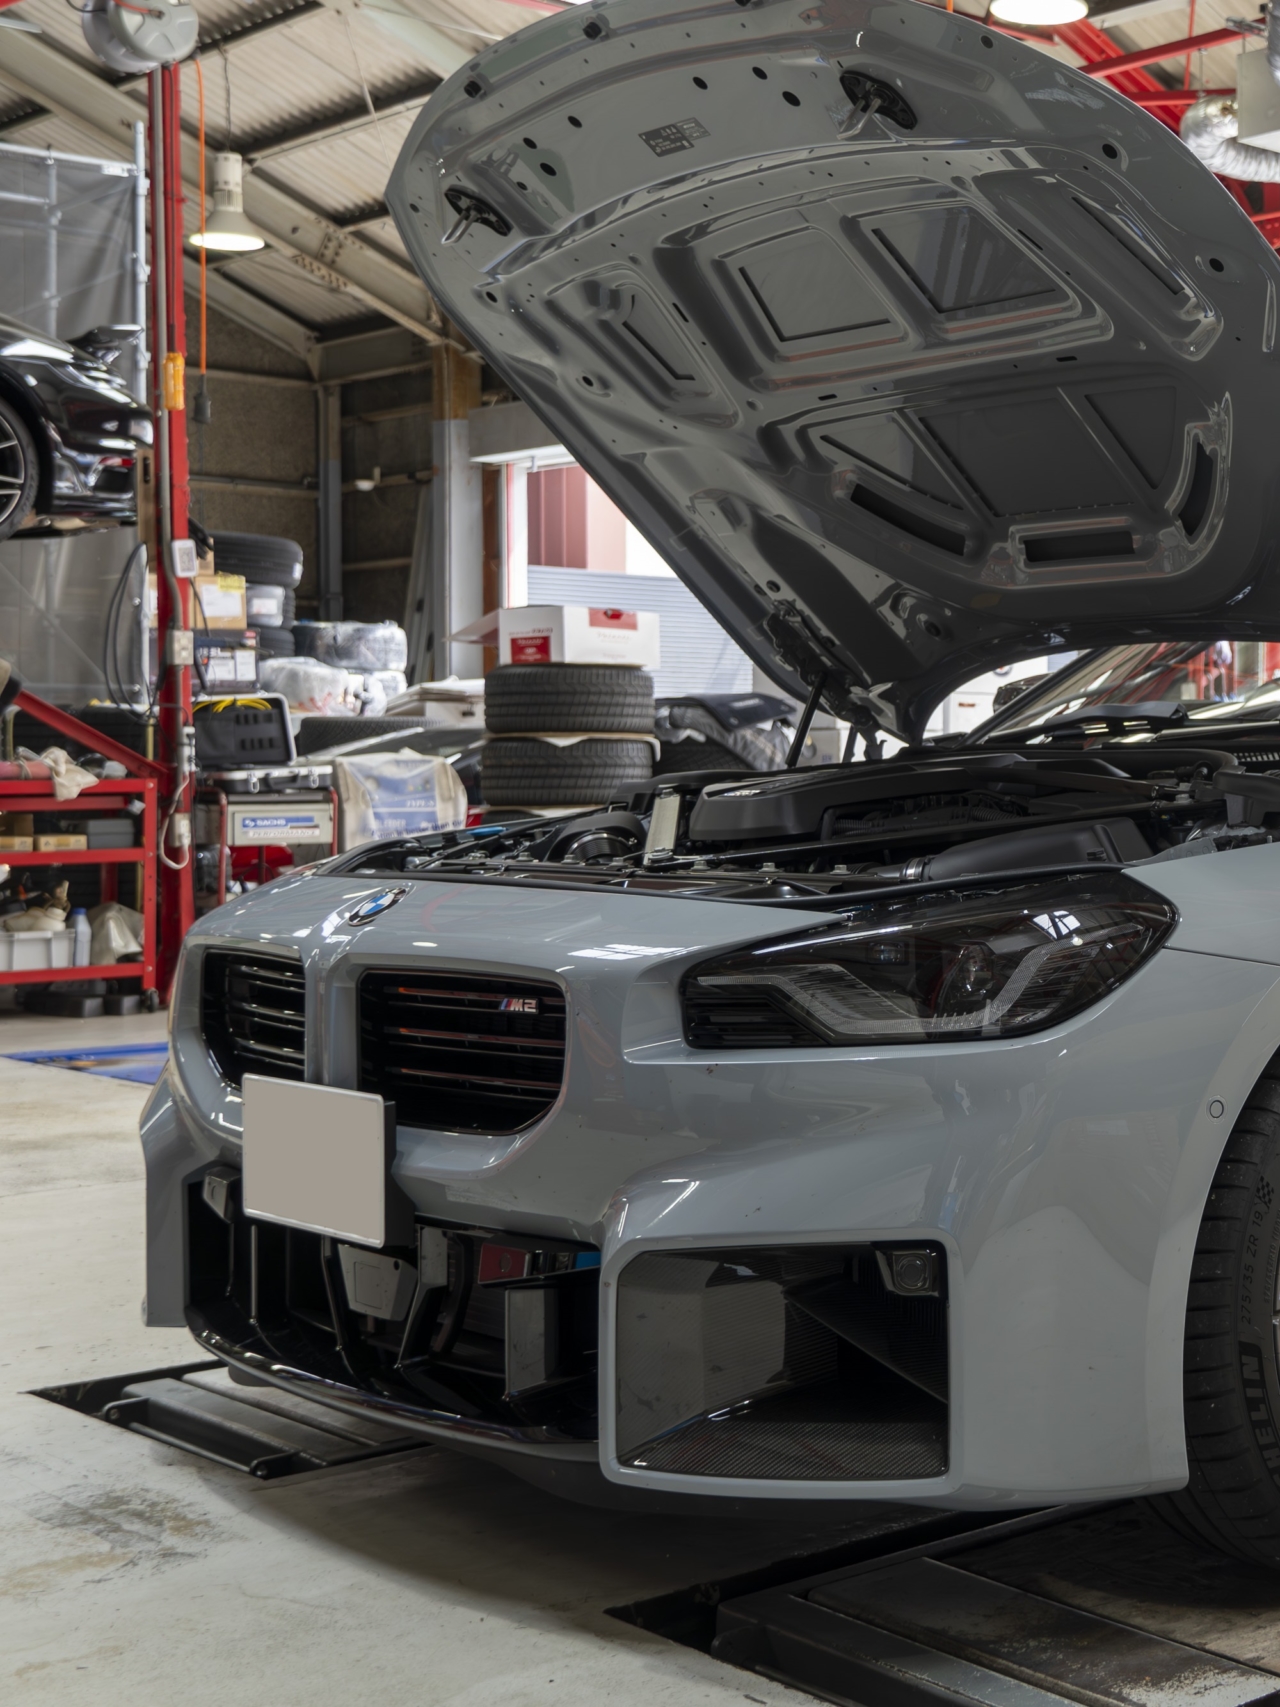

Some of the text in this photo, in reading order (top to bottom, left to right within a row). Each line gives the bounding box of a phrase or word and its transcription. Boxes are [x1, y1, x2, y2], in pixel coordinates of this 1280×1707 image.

[256, 818, 287, 827] SACHS
[252, 829, 316, 838] PERFORMANCE
[508, 998, 538, 1013] M2
[1240, 1210, 1266, 1326] 275/35 ZR 19
